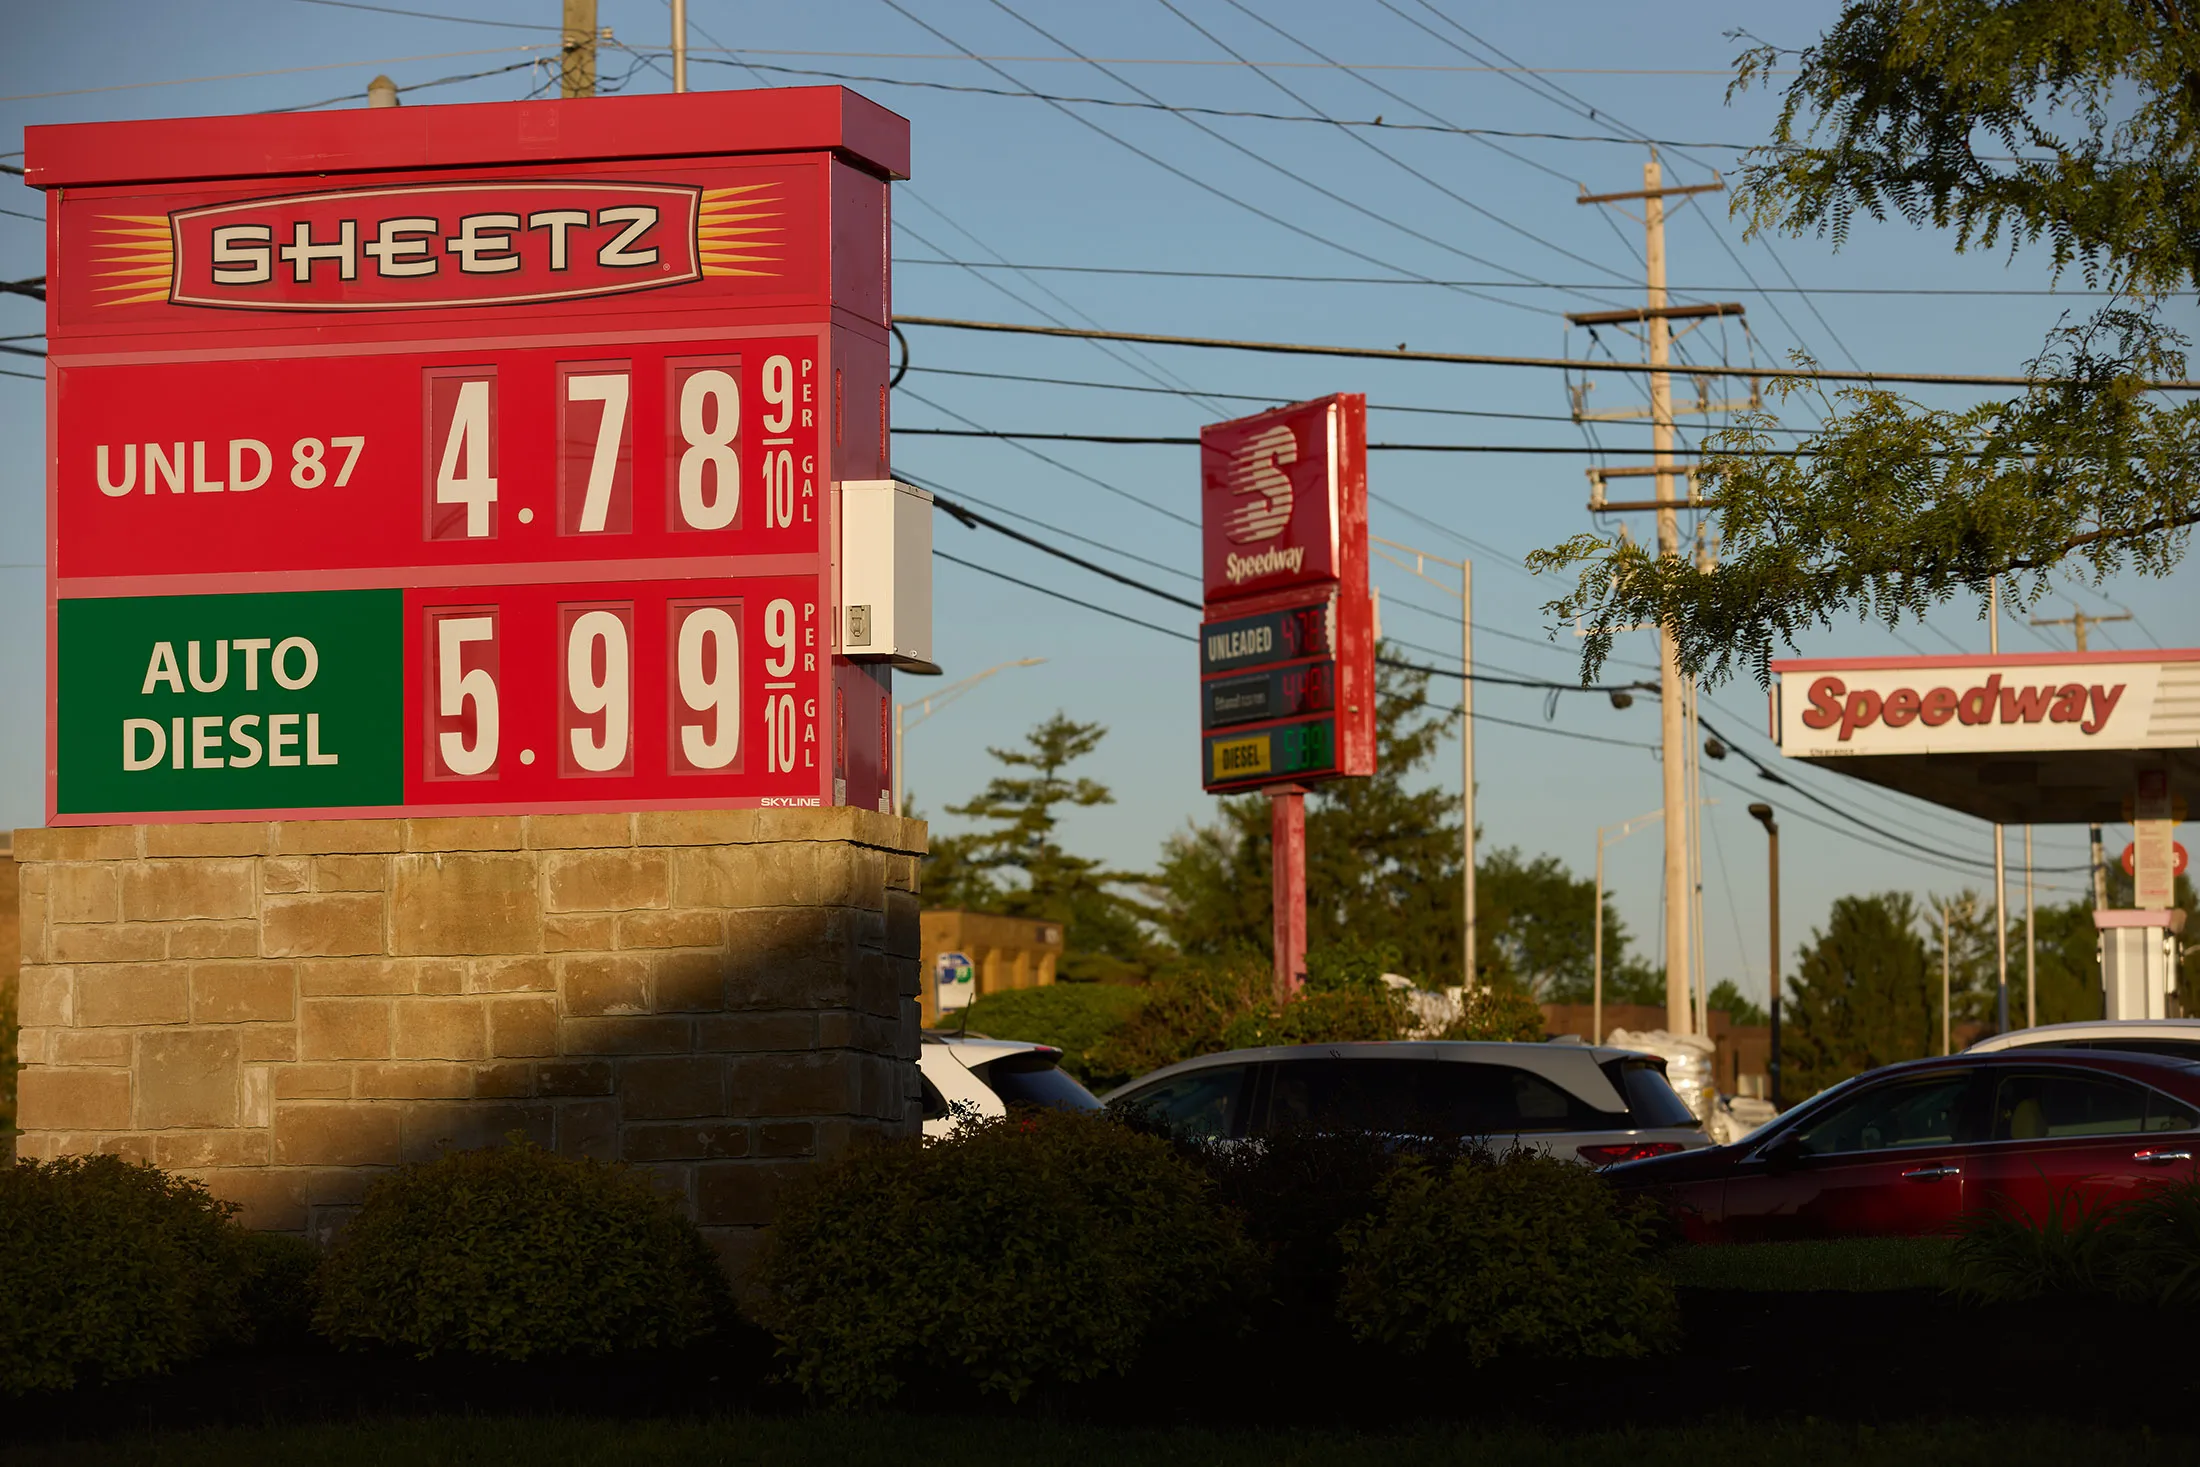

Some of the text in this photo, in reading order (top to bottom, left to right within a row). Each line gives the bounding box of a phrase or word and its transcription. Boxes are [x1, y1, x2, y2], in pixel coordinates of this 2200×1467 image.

[212, 205, 660, 285] SHEETZ
[801, 358, 813, 427] PER
[96, 436, 365, 497] UNLD 87
[801, 455, 814, 523] GAL
[1226, 546, 1304, 585] Speedway
[141, 636, 319, 694] AUTO
[804, 603, 815, 671] PER
[1208, 625, 1273, 662] UNLEADED
[804, 699, 815, 768] GAL
[1802, 673, 2127, 741] Speedway
[123, 713, 339, 771] DIESEL
[1222, 743, 1261, 770] DIESEL
[761, 797, 821, 807] SKYLINE
